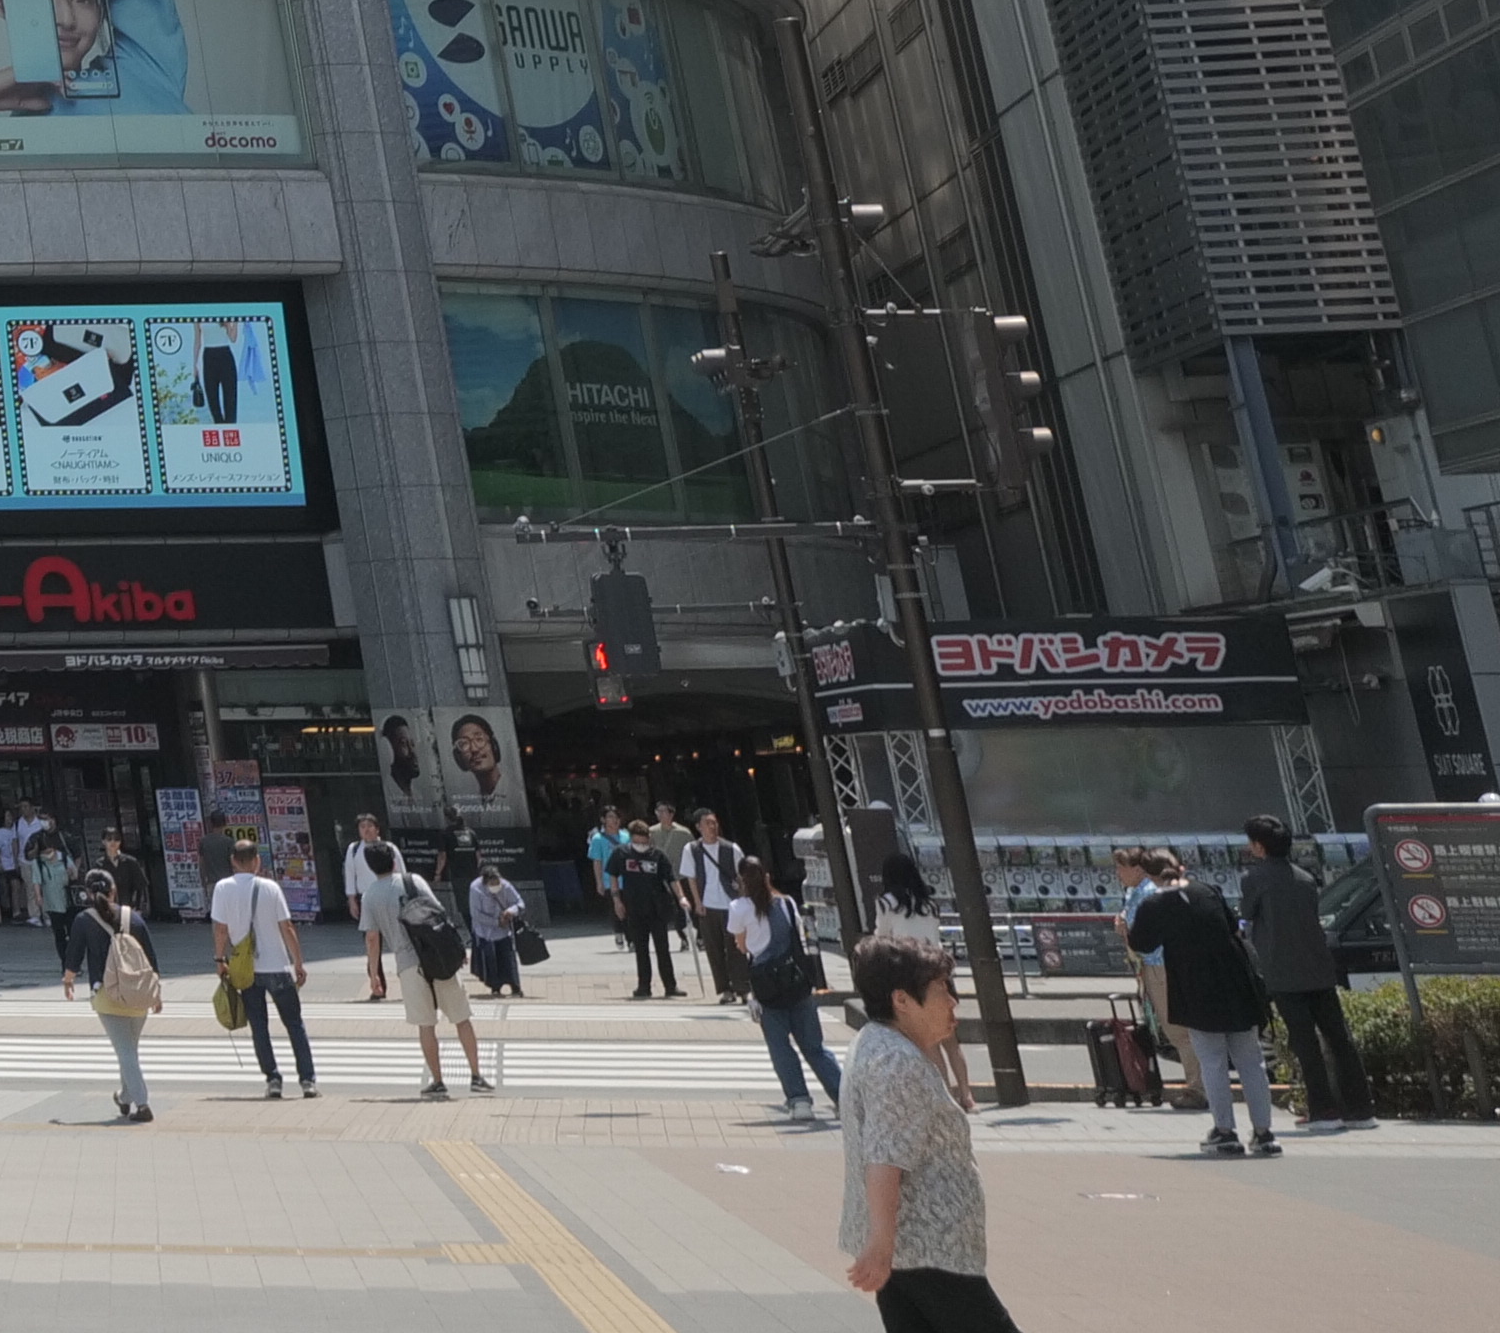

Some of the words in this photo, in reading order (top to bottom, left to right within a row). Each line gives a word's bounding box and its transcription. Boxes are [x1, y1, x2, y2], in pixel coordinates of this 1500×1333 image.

[205, 131, 278, 150] docomo
[566, 382, 650, 409] HITACHI
[202, 452, 243, 463] UNIQLO
[65, 654, 144, 667] ヨドバシカメラ
[930, 633, 1226, 677] ヨドバシカメラ
[963, 691, 1223, 719] www.yodobashi.com
